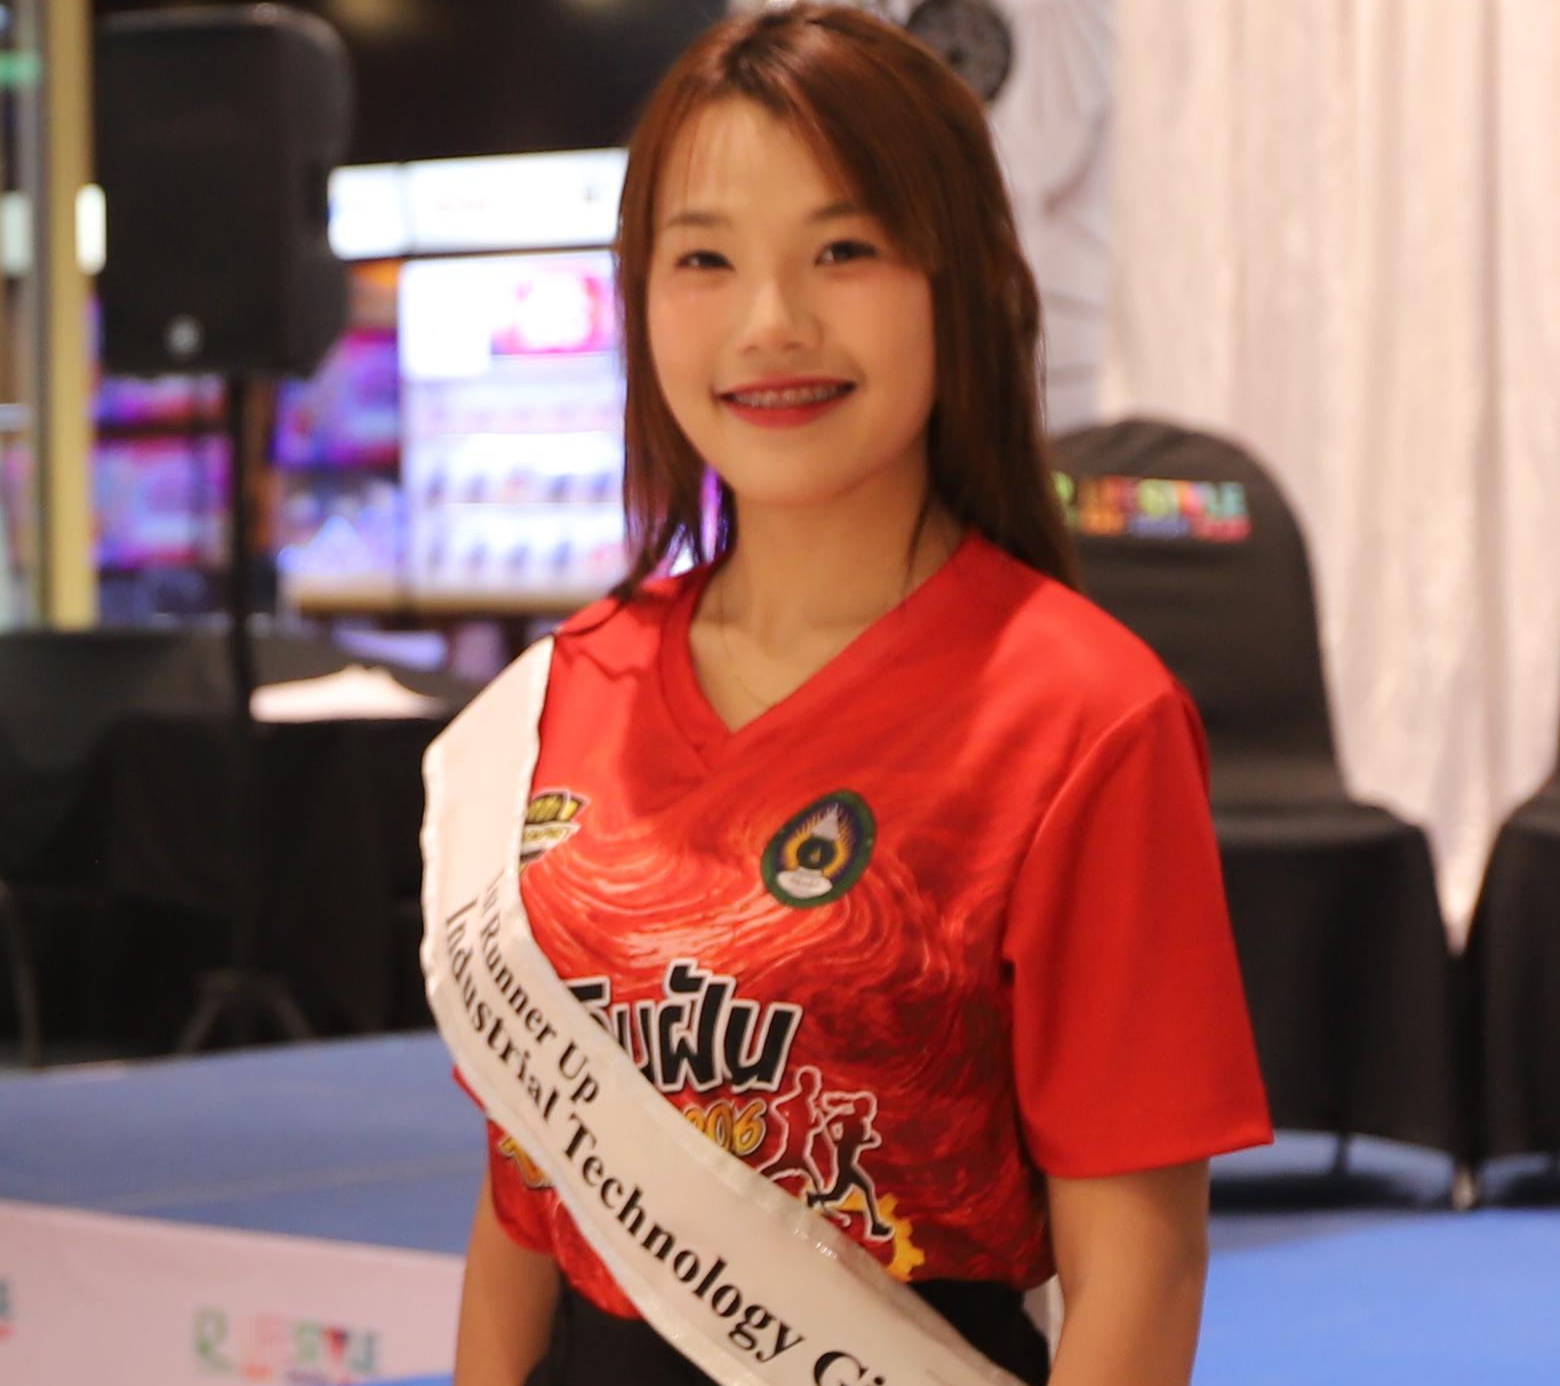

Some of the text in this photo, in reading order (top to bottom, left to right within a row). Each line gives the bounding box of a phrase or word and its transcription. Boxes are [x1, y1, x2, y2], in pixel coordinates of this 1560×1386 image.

[446, 898, 560, 1122] Industrial
[563, 1113, 805, 1363] Technology
[480, 911, 558, 1045] Runner
[558, 1041, 600, 1105] Up
